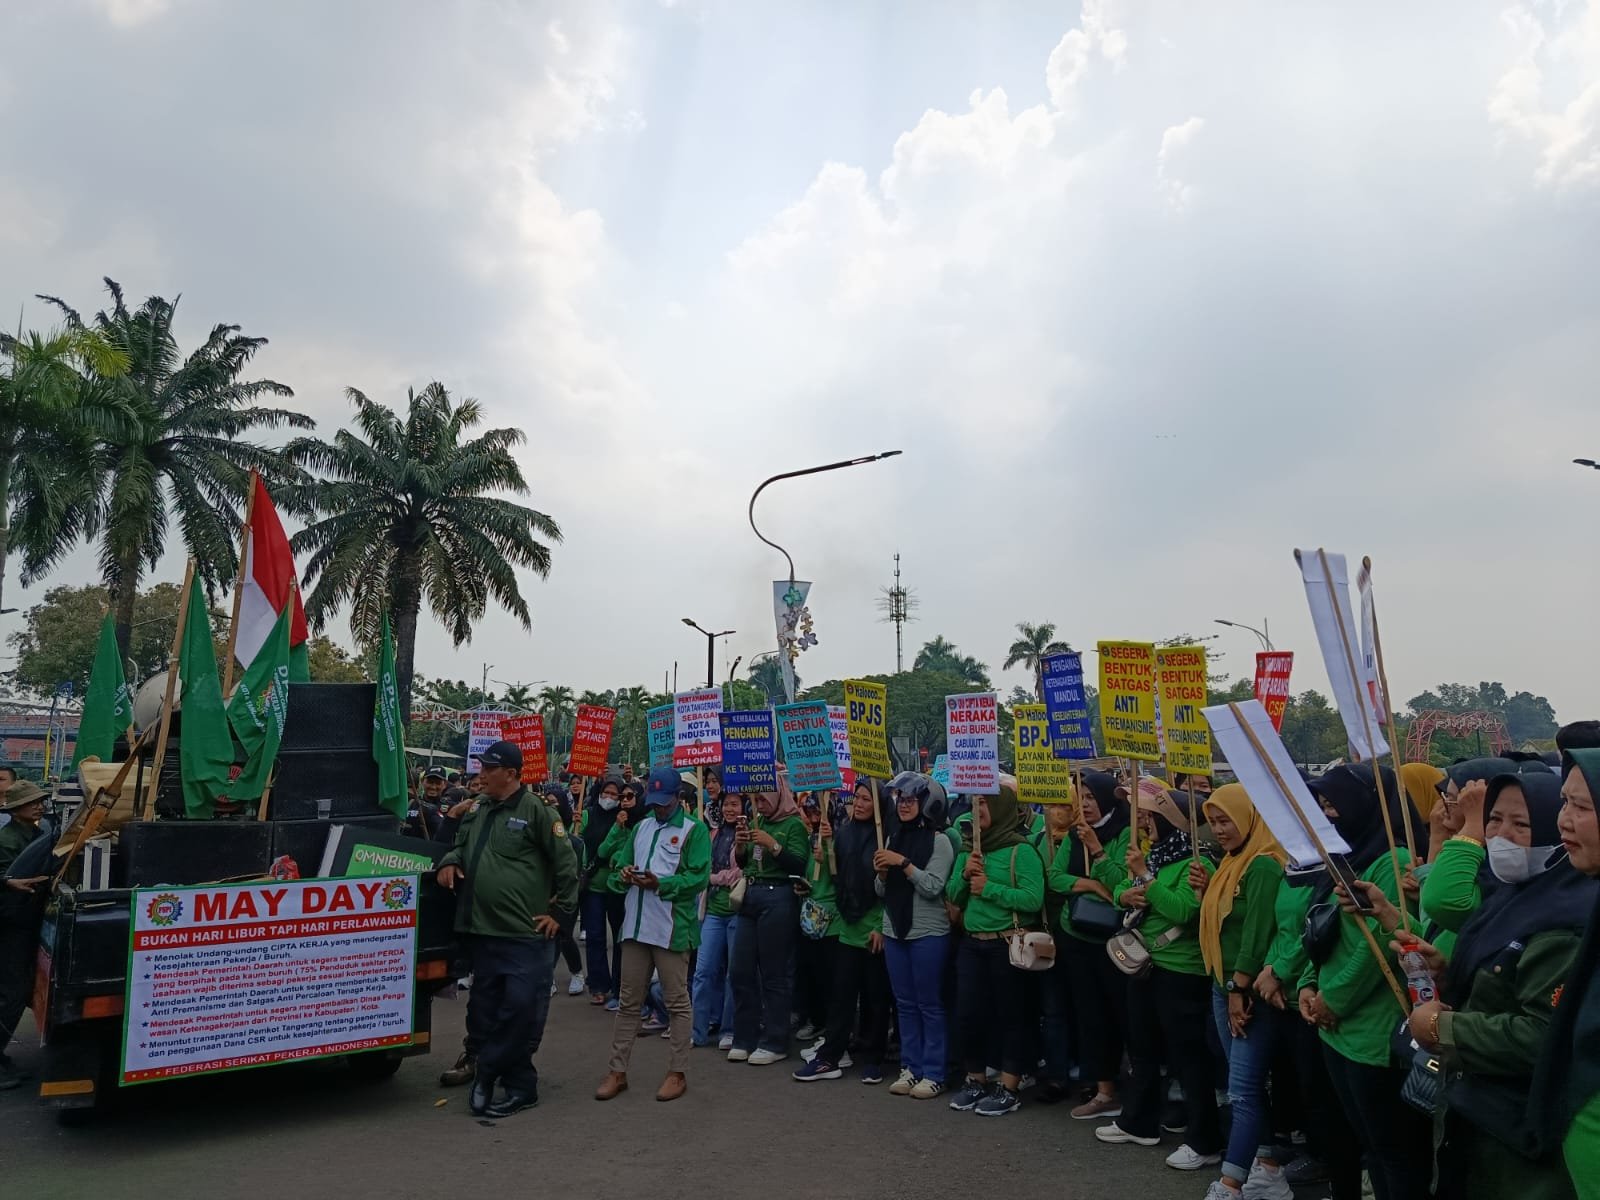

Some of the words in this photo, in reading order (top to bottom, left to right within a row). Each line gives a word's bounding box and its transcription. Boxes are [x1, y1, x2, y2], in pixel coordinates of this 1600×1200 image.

[1111, 646, 1149, 660] SEGERA
[1050, 657, 1080, 672] PENGAWAS
[1166, 654, 1200, 667] SEGERA
[1104, 662, 1152, 676] BENTUK
[1162, 670, 1203, 682] BENTUK
[1107, 678, 1150, 692] SATGAS
[1054, 690, 1080, 703] MANDUL
[1166, 687, 1203, 700] SATGAS
[1114, 695, 1138, 714] ANTI
[732, 714, 769, 722] KEMBALIKAN
[788, 707, 822, 717] SEGERA
[850, 701, 882, 726] BPJS
[950, 710, 996, 722] NERAKA
[1174, 705, 1194, 723] ANTI
[688, 721, 710, 730] KOTA
[784, 717, 826, 732] BENTUK
[950, 726, 967, 734] BAGI
[970, 725, 996, 734] BURUH
[1106, 716, 1153, 734] PREMANISME
[577, 730, 606, 743] CIPTAKER
[679, 729, 720, 740] INDUSTRI
[724, 727, 769, 740] PENGAWAS
[1020, 726, 1050, 747] BPJ
[1168, 729, 1207, 744] PREMANISME
[788, 734, 826, 749] PERDA
[686, 746, 714, 755] TOLAK
[744, 752, 770, 760] PROVINSI
[950, 751, 980, 760] SEKARANG
[981, 751, 995, 760] JUGA
[1018, 752, 1044, 760] LAYANI
[676, 756, 720, 766] RELOKASI
[738, 764, 773, 772] TINGKAT
[750, 774, 774, 782] KOTA
[740, 784, 774, 792] KABUPATEN
[193, 888, 288, 922] MAY
[302, 882, 382, 914] DAY
[140, 934, 188, 946] BUKAN
[192, 931, 224, 942] HARI
[228, 928, 266, 939] LIBUR
[270, 924, 296, 936] TAPI
[301, 922, 329, 933] HARI
[333, 915, 411, 930] PERLAWANAN
[154, 953, 194, 962] Menolak
[196, 946, 268, 958] Undang-undang
[271, 942, 297, 951] CIPTA
[300, 940, 329, 948] KERJA
[330, 938, 350, 948] yang
[353, 933, 408, 944] mendegradasi
[154, 959, 220, 970] Kesejahteraan
[224, 956, 256, 966] Pekerja
[154, 970, 199, 980] Mendesak
[202, 965, 251, 975] Pemerintah
[254, 962, 284, 970] Daerah
[286, 958, 308, 966] untuk
[311, 956, 338, 965] segera
[340, 952, 376, 962] membuat
[378, 948, 404, 958] PERDA
[152, 982, 175, 990] yang
[178, 977, 216, 988] berpihak
[219, 974, 240, 983] pada
[242, 972, 266, 980] kaum
[268, 969, 292, 978] buruh
[320, 962, 358, 972] Penduduk
[362, 960, 386, 968] sekitar
[388, 958, 400, 966] per
[152, 988, 191, 998] usahaan
[194, 984, 216, 994] wajib
[219, 980, 254, 990] diterima
[286, 976, 316, 984] pekerja
[318, 972, 345, 980] sesuai
[152, 997, 196, 1007] Mendesak
[200, 992, 248, 1002] Pemerintah
[250, 988, 279, 996] Daerah
[282, 985, 304, 993] untuk
[306, 982, 332, 992] segera
[334, 977, 378, 988] membentuk
[381, 974, 406, 983] Satgas
[151, 1008, 170, 1016] Anti
[172, 1002, 226, 1014] Premanisme
[228, 1000, 244, 1008] dan
[246, 996, 274, 1006] Satgas
[296, 990, 334, 1000] Percaloan
[337, 987, 364, 996] Tenaga
[150, 1018, 194, 1028] Mendesak
[196, 1012, 244, 1023] Pemerintah
[246, 1008, 268, 1017] untuk
[270, 1006, 297, 1014] segera
[300, 998, 358, 1010] mengembalikan
[360, 994, 380, 1002] Dinas
[382, 992, 406, 1001] Penga
[150, 1029, 178, 1037] wasan
[180, 1020, 250, 1034] Ketenagakerjaan
[252, 1016, 266, 1024] dari
[270, 1013, 302, 1022] Provinsi
[315, 1006, 356, 1017] Kabupaten
[149, 1039, 190, 1049] Menuntut
[194, 1029, 246, 1042] transparansi
[248, 1026, 280, 1036] Pemkot
[282, 1022, 322, 1032] Tangerang
[325, 1017, 354, 1026] tentang
[356, 1012, 399, 1022] penerimaan
[148, 1050, 165, 1058] dan
[168, 1043, 222, 1056] penggunaan
[224, 1040, 245, 1048] Dana
[248, 1036, 266, 1045] CSR
[268, 1032, 290, 1041] untuk
[293, 1026, 347, 1038] kesejahteraan
[349, 1022, 376, 1032] pekerja
[165, 1062, 222, 1075] FEDERASI
[226, 1055, 271, 1066] SERIKAT
[274, 1048, 322, 1060] PEKERJA
[325, 1040, 379, 1052] INDONESIA
